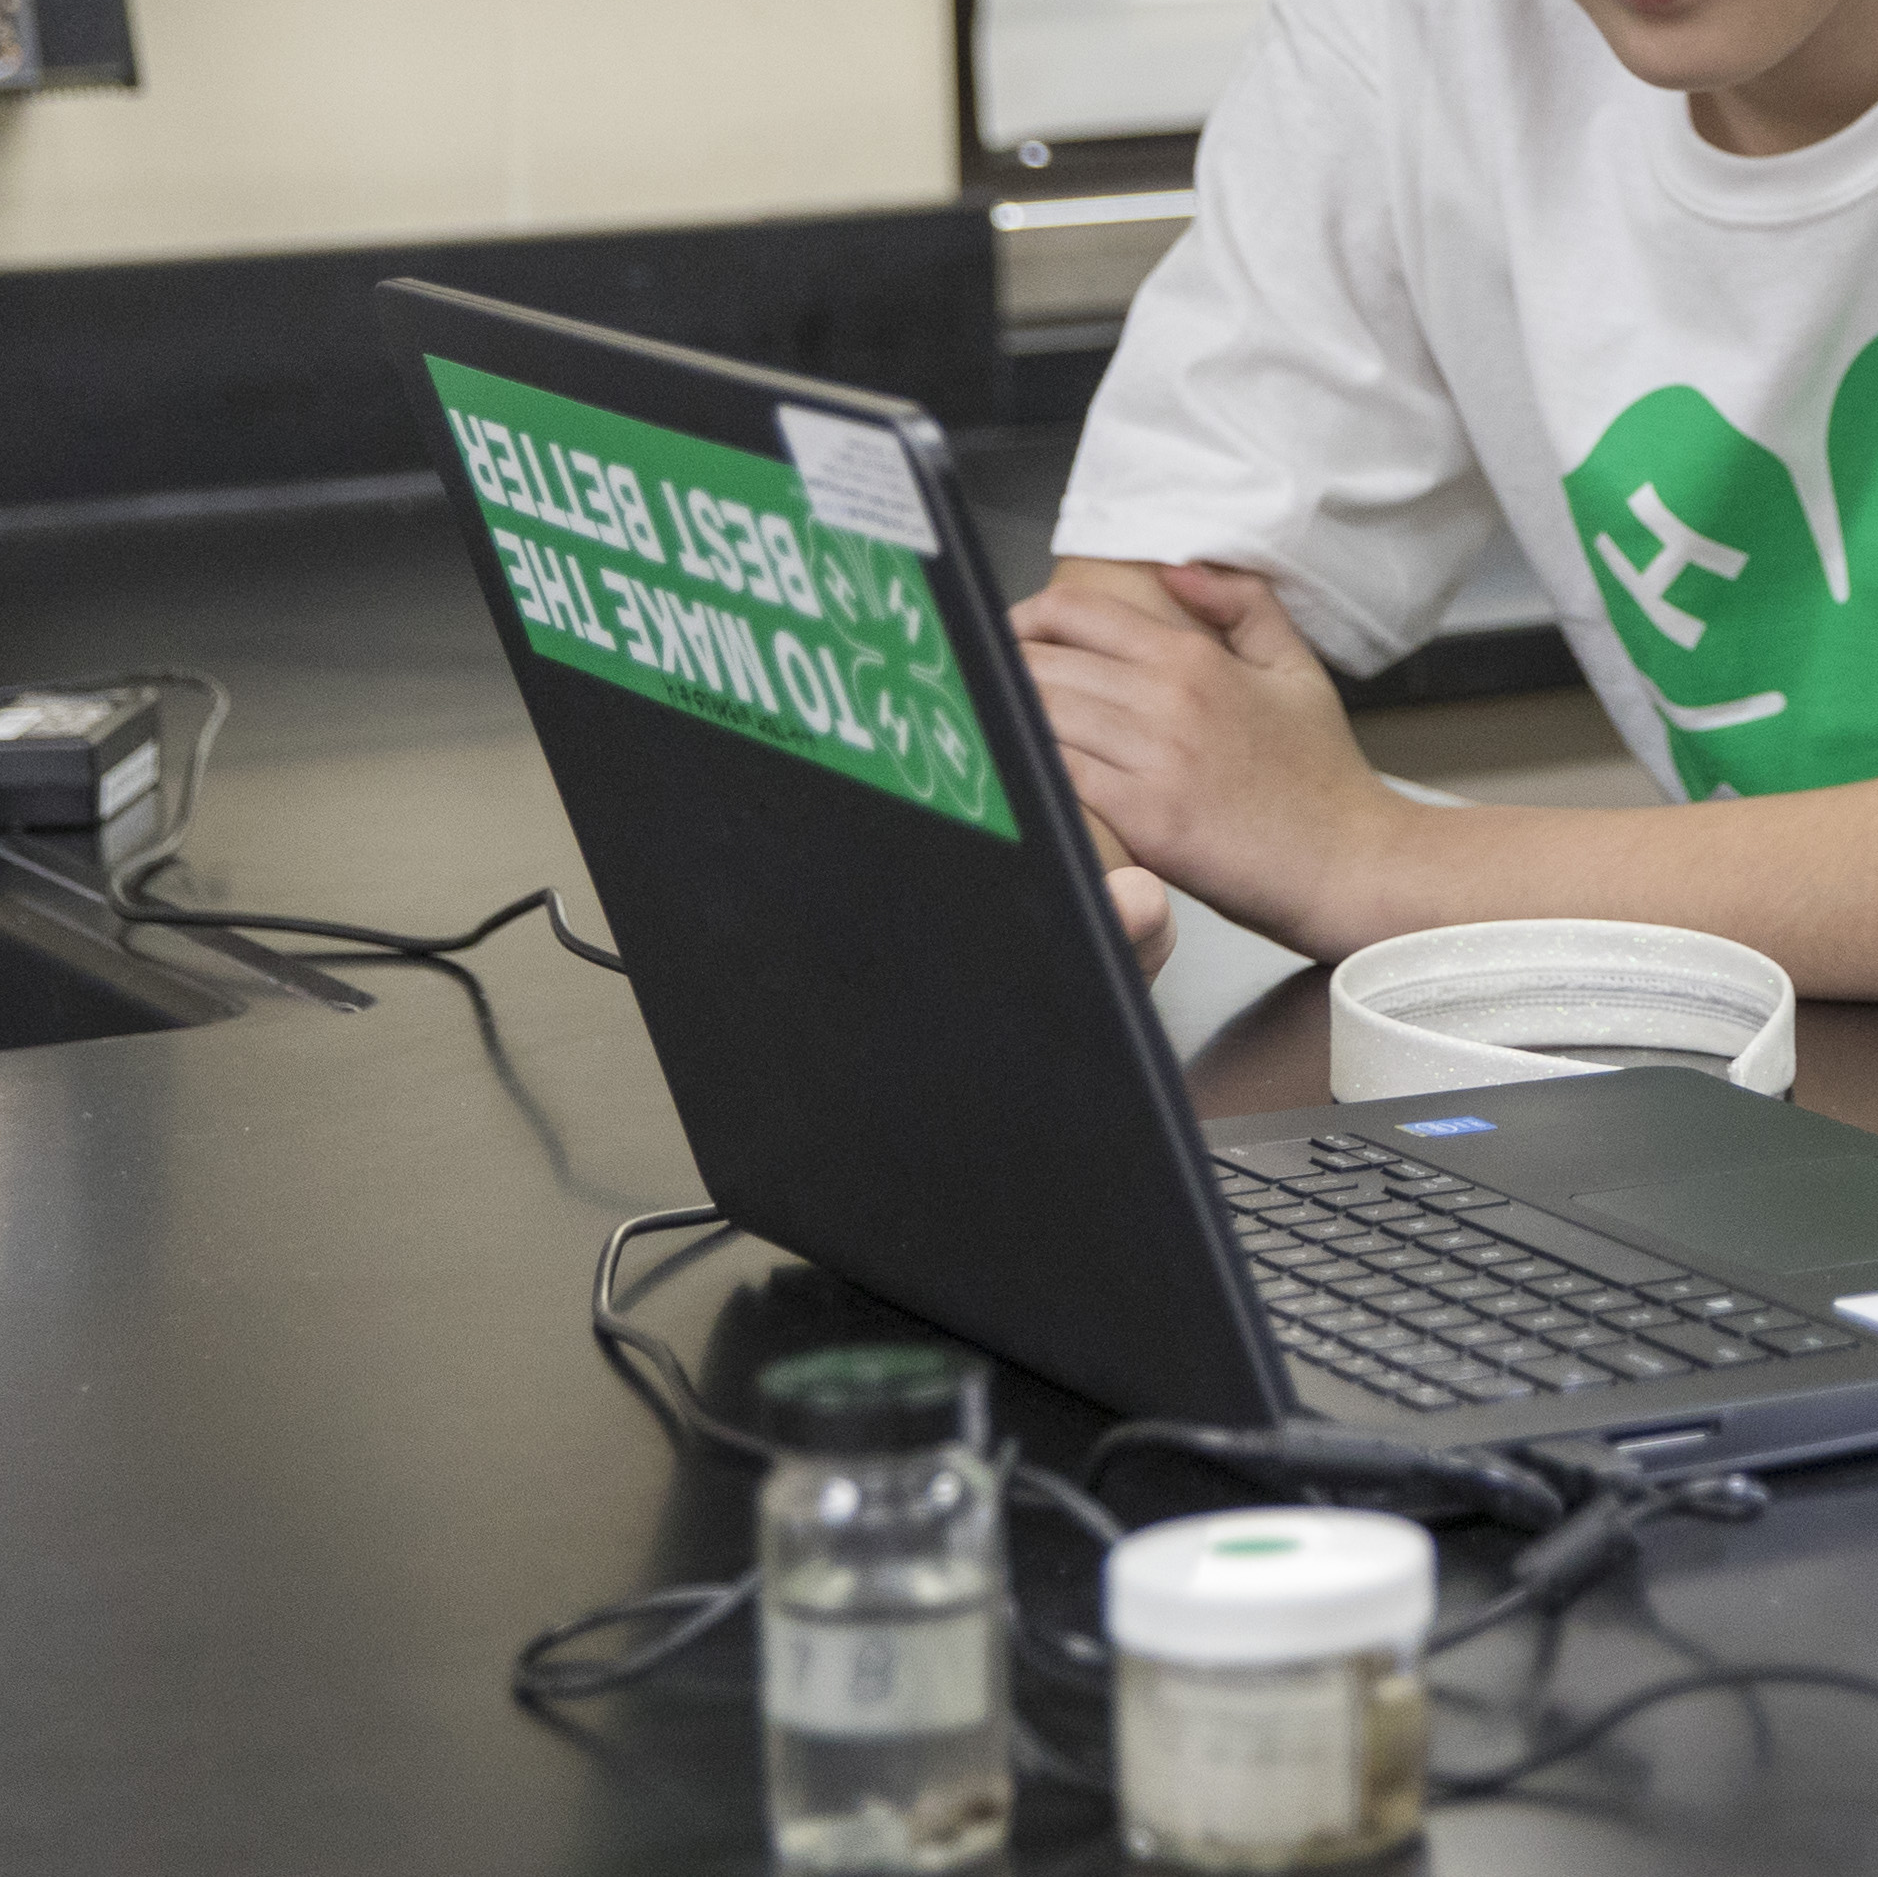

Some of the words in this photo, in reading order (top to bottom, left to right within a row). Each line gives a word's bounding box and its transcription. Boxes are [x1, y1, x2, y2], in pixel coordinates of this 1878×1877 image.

[448, 407, 667, 564] BETTER
[660, 480, 823, 620] BEST
[494, 527, 617, 651] THE
[600, 567, 780, 714] MAKE
[772, 629, 876, 751] TO
